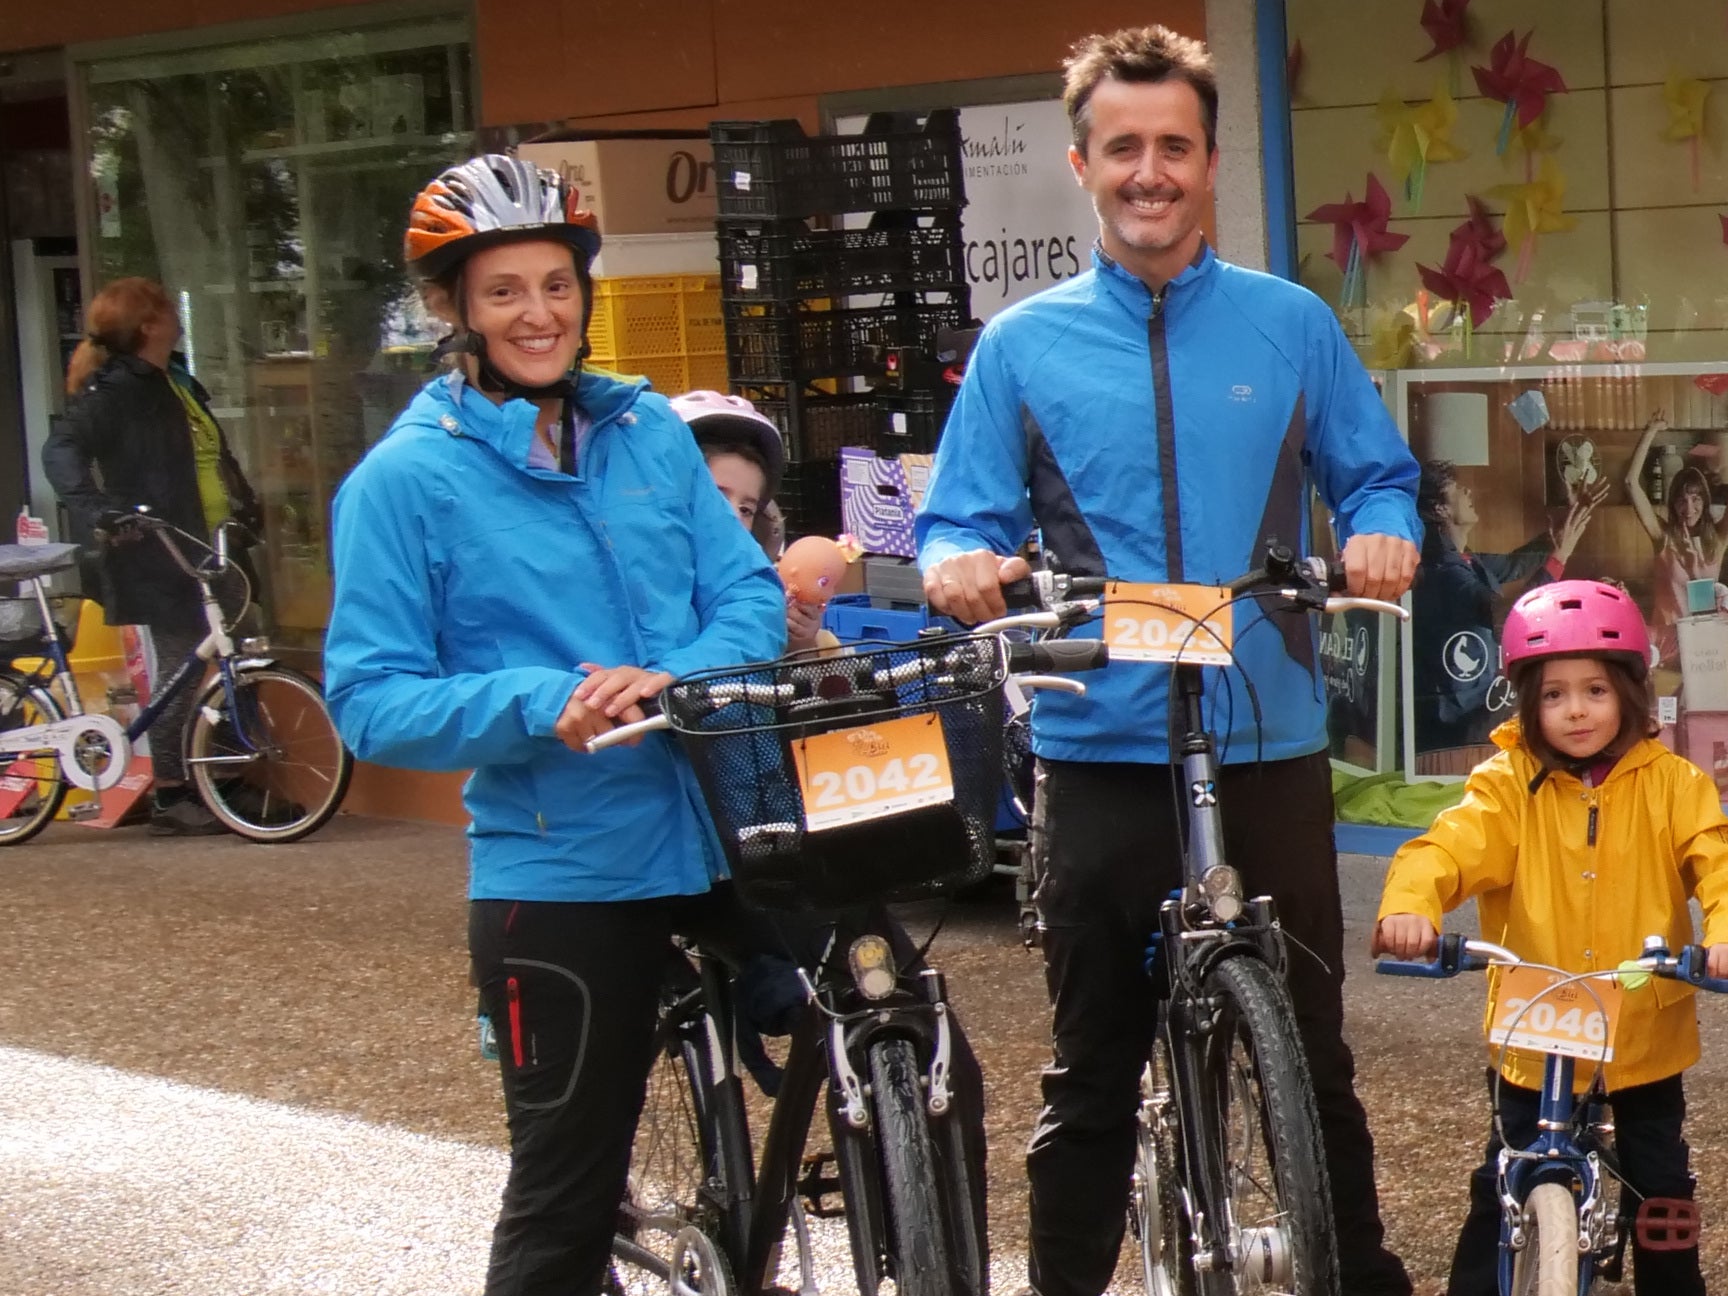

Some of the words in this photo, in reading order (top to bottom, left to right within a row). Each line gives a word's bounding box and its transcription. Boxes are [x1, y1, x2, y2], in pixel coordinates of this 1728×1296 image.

[1114, 617, 1223, 650] 2043
[812, 754, 942, 808] 2042
[1501, 997, 1606, 1042] 2046
